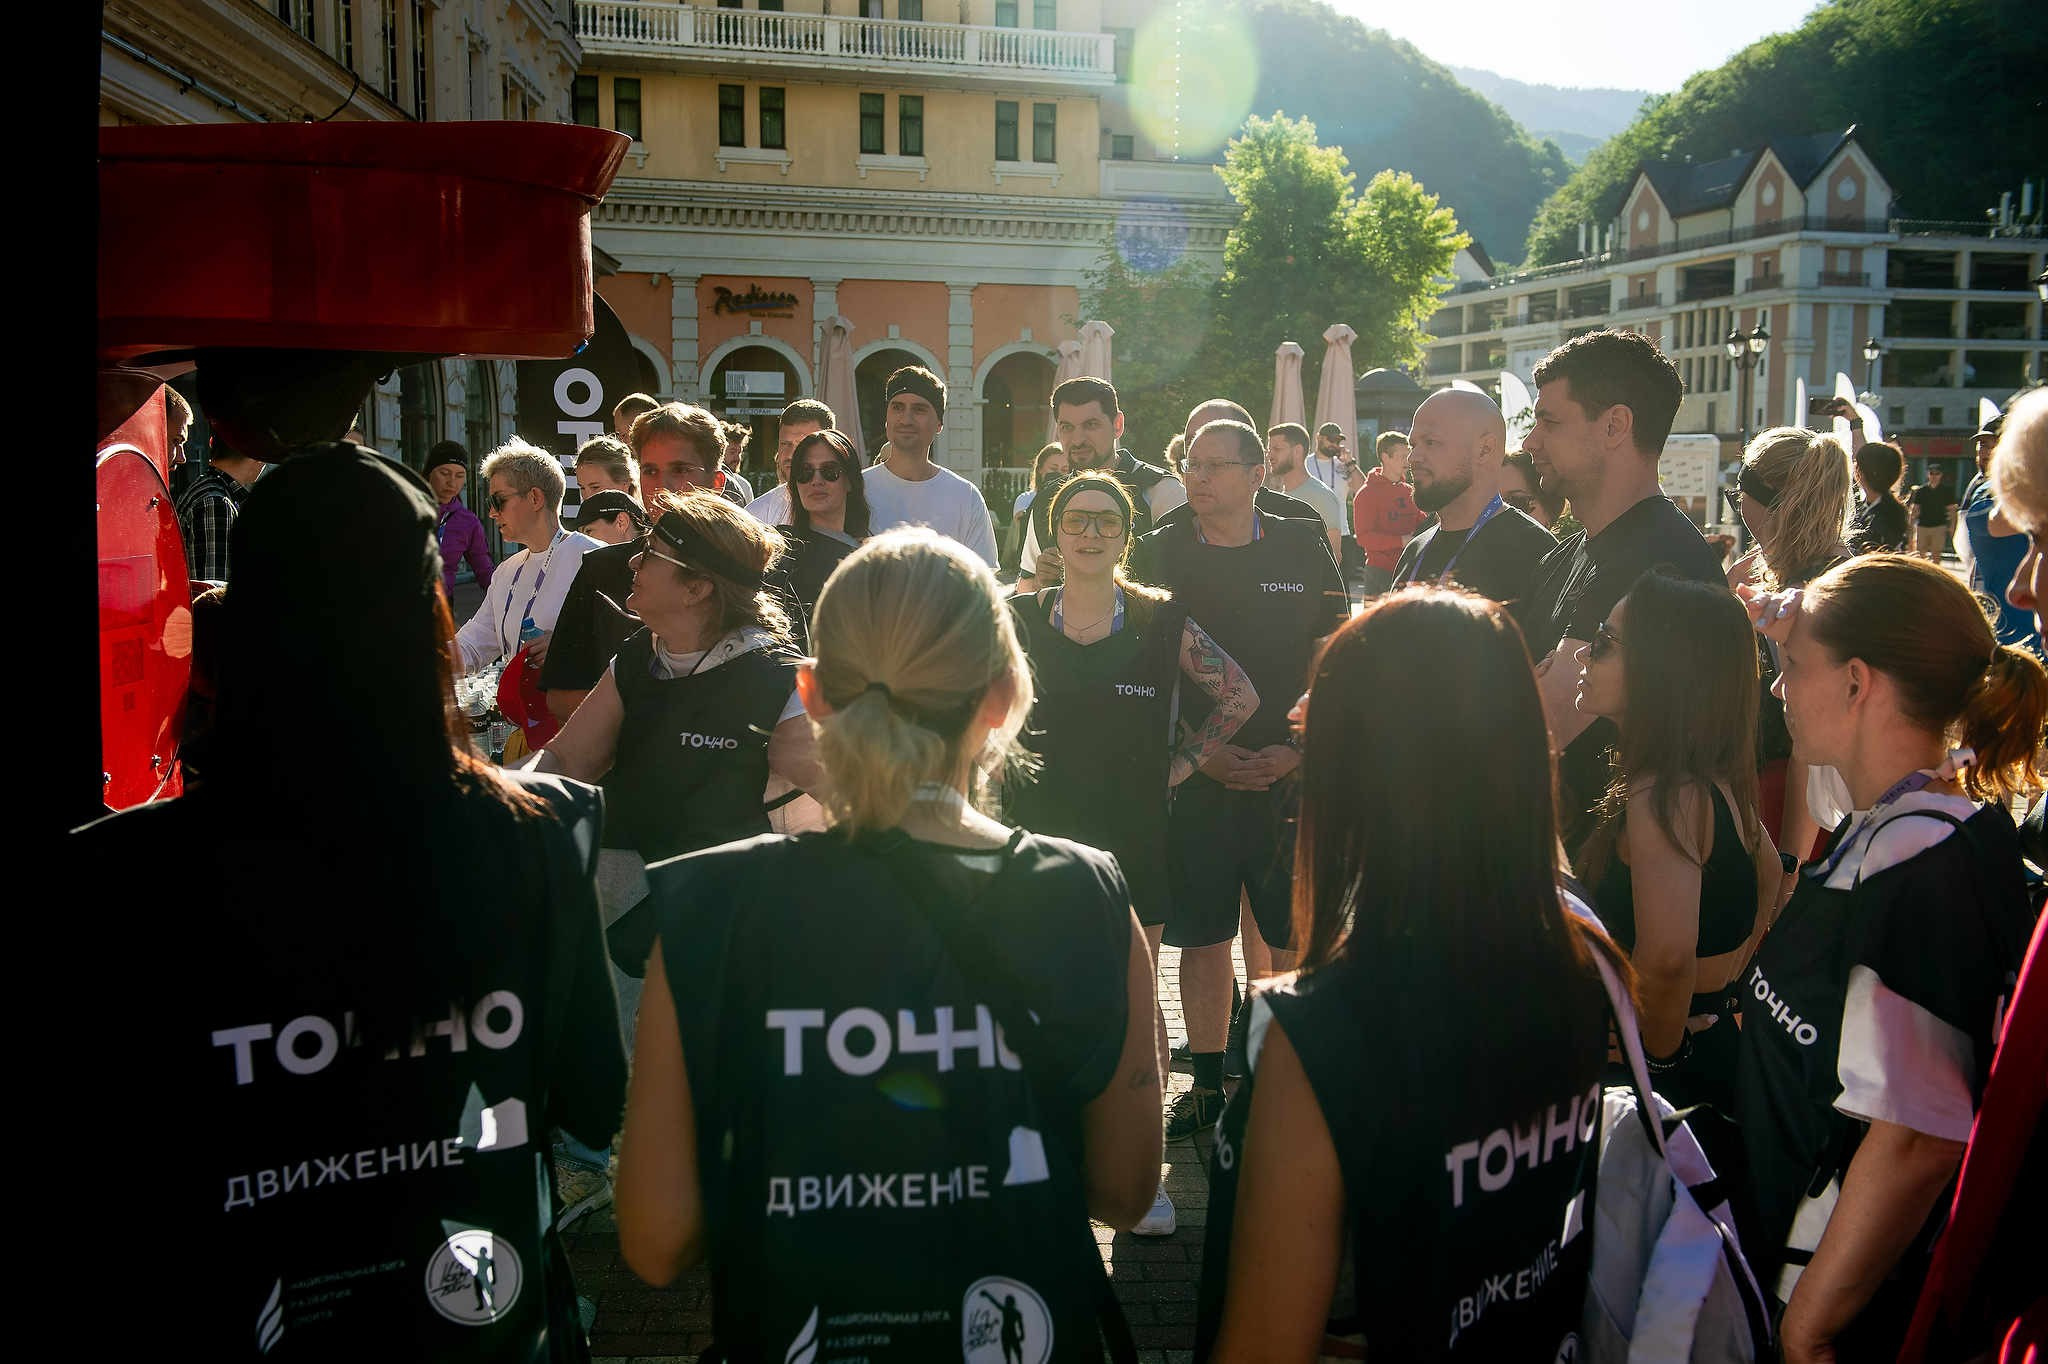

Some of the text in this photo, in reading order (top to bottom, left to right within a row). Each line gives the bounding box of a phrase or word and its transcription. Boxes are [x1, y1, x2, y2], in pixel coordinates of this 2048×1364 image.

[1260, 582, 1304, 593] ТОЧНО
[1115, 684, 1156, 697] ТОЧНО
[680, 732, 738, 749] ТОЧНО
[1749, 966, 1818, 1046] ТОЧНО
[1445, 1082, 1600, 1209] ТОЧНО
[223, 1136, 465, 1213] ДВИЖЕНИЕ
